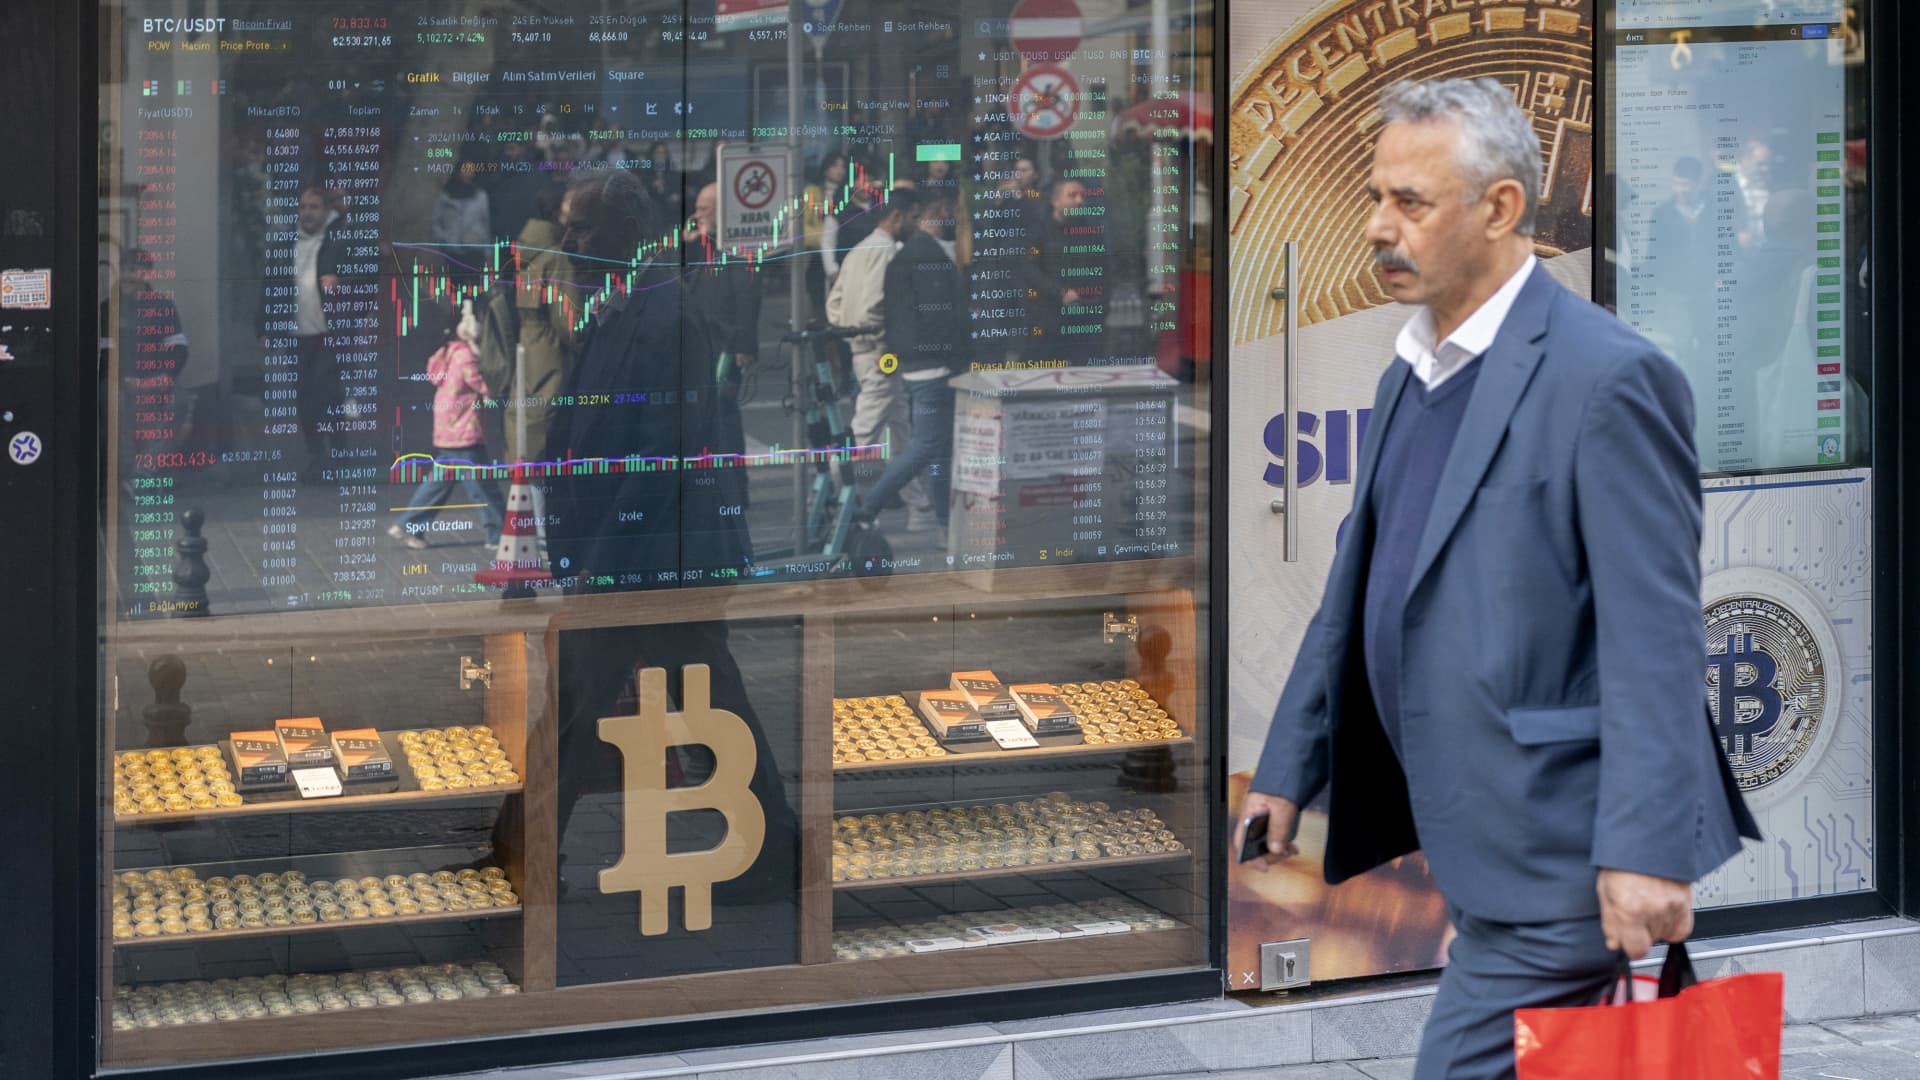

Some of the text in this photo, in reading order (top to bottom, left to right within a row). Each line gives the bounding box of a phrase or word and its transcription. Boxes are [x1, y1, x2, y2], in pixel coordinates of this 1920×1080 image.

[143, 18, 226, 33] BTC/USDT
[333, 18, 387, 29] 73,833.43
[530, 17, 542, 25] En
[607, 16, 618, 24] En
[418, 33, 485, 44] 5,102.72 +7.42%
[512, 33, 551, 43] 75,407.10
[589, 32, 628, 43] 68,666.00
[148, 42, 170, 51] POW
[221, 41, 244, 51] Price
[993, 52, 1015, 61] USDT
[1133, 50, 1150, 59] BTC
[408, 73, 440, 83] Grafik
[453, 72, 490, 84] Bilgiler
[559, 71, 596, 81] Verileri
[609, 71, 645, 82] Square
[329, 80, 347, 90] 0.01
[137, 105, 381, 119] Fiyat(USDT) Miktar(BTC) Toplam
[410, 107, 440, 117] Zaman
[476, 105, 500, 115] 15dak
[536, 105, 547, 114] 4S
[560, 104, 571, 113] 1G
[584, 104, 595, 113] 1H
[498, 131, 533, 141] 69372.01
[589, 131, 625, 141] 75407.10
[628, 130, 639, 139] En
[752, 128, 788, 138] 73833.43
[833, 126, 857, 136] 6.38%
[427, 148, 453, 158] 8.80%
[616, 160, 653, 170] 62477.38
[983, 228, 1026, 238] AEVO/BTC
[981, 271, 1012, 280] AI/BTC
[981, 289, 1024, 300] ALGO/BTC
[981, 309, 1025, 319] ALICE/BTC
[981, 327, 1029, 338] ALPHA/BTC
[971, 363, 1003, 375] Piyasa
[552, 397, 574, 406] 4.91B
[578, 395, 611, 406] 33.271K
[1135, 401, 1166, 412] 13:56:40
[1135, 433, 1166, 444] 13:56:40
[332, 449, 355, 458] Daha
[1135, 449, 1166, 459] 13:56:40
[136, 452, 206, 470] 73,833.43
[1135, 464, 1167, 475] 13:56:39
[1135, 480, 1167, 490] 13:56:39
[1135, 496, 1167, 506] 13:56:39
[719, 505, 741, 516] Grid
[1073, 511, 1167, 526] 0.00014 13:56:39
[406, 522, 430, 535] Spot
[1073, 527, 1167, 542] 0.00059 13:56:39
[1152, 541, 1179, 552] Destek
[881, 557, 921, 569] Duyurular
[402, 585, 444, 596] APTUSDT
[525, 577, 578, 589] FORTHUSDT
[620, 574, 642, 585] 2.986
